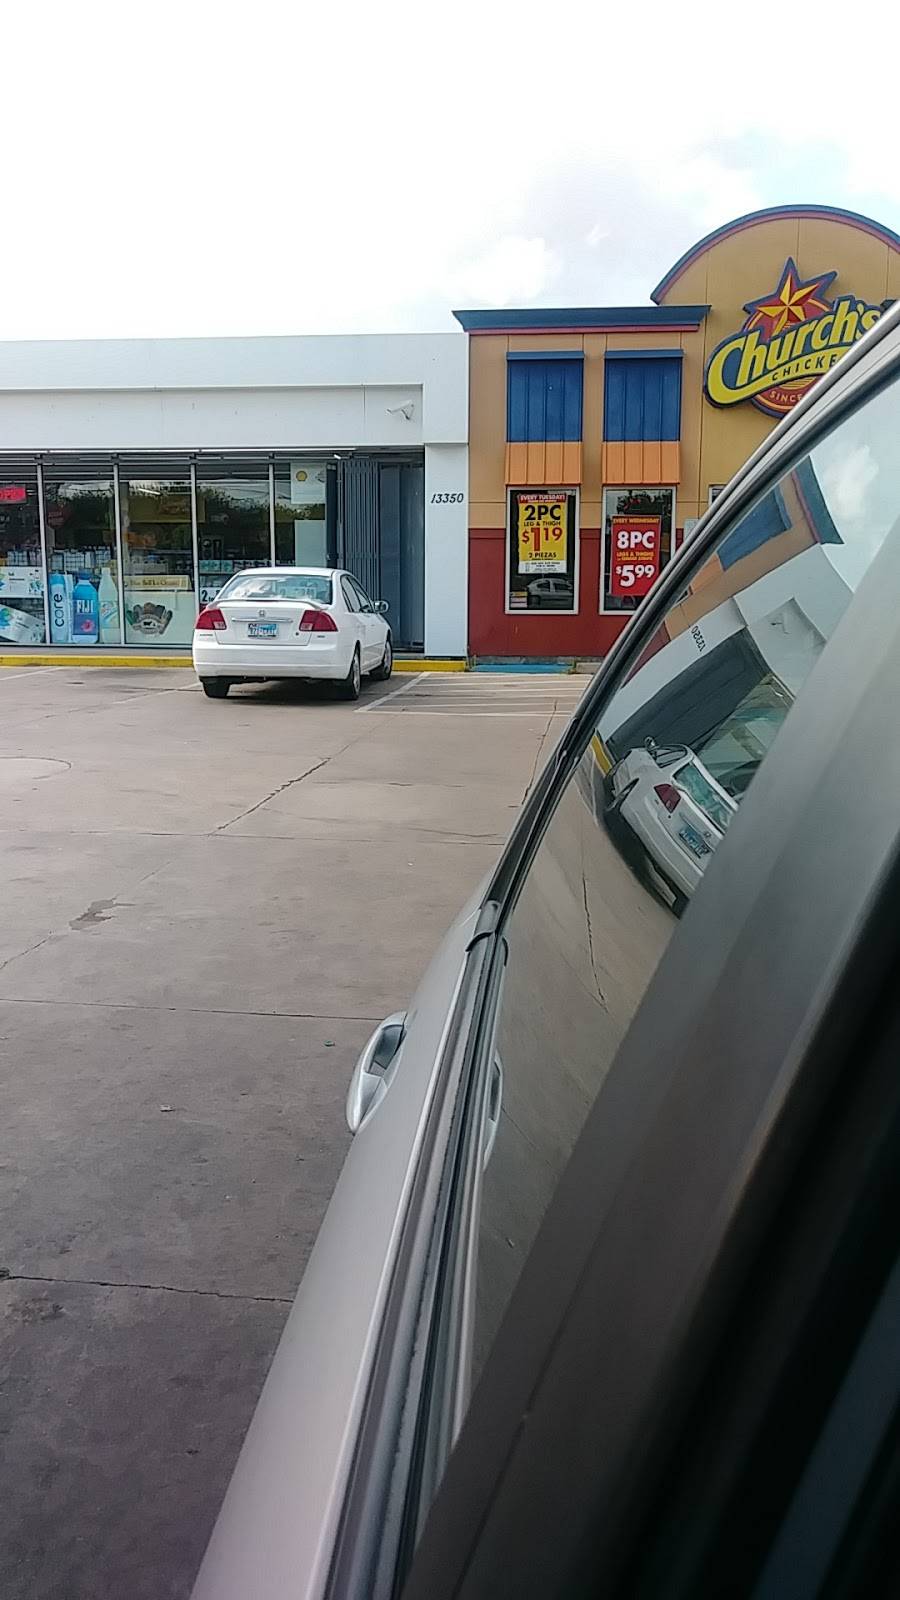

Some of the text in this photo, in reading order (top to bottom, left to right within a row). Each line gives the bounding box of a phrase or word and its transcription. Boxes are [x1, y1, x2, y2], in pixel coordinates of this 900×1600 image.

[708, 301, 881, 404] Church's
[772, 354, 838, 381] CHICKE
[431, 493, 464, 504] 13350
[524, 505, 561, 521] 2PC
[617, 531, 655, 549] 8PC
[201, 589, 208, 602] 2
[54, 593, 65, 628] core
[76, 599, 94, 613] FIJI
